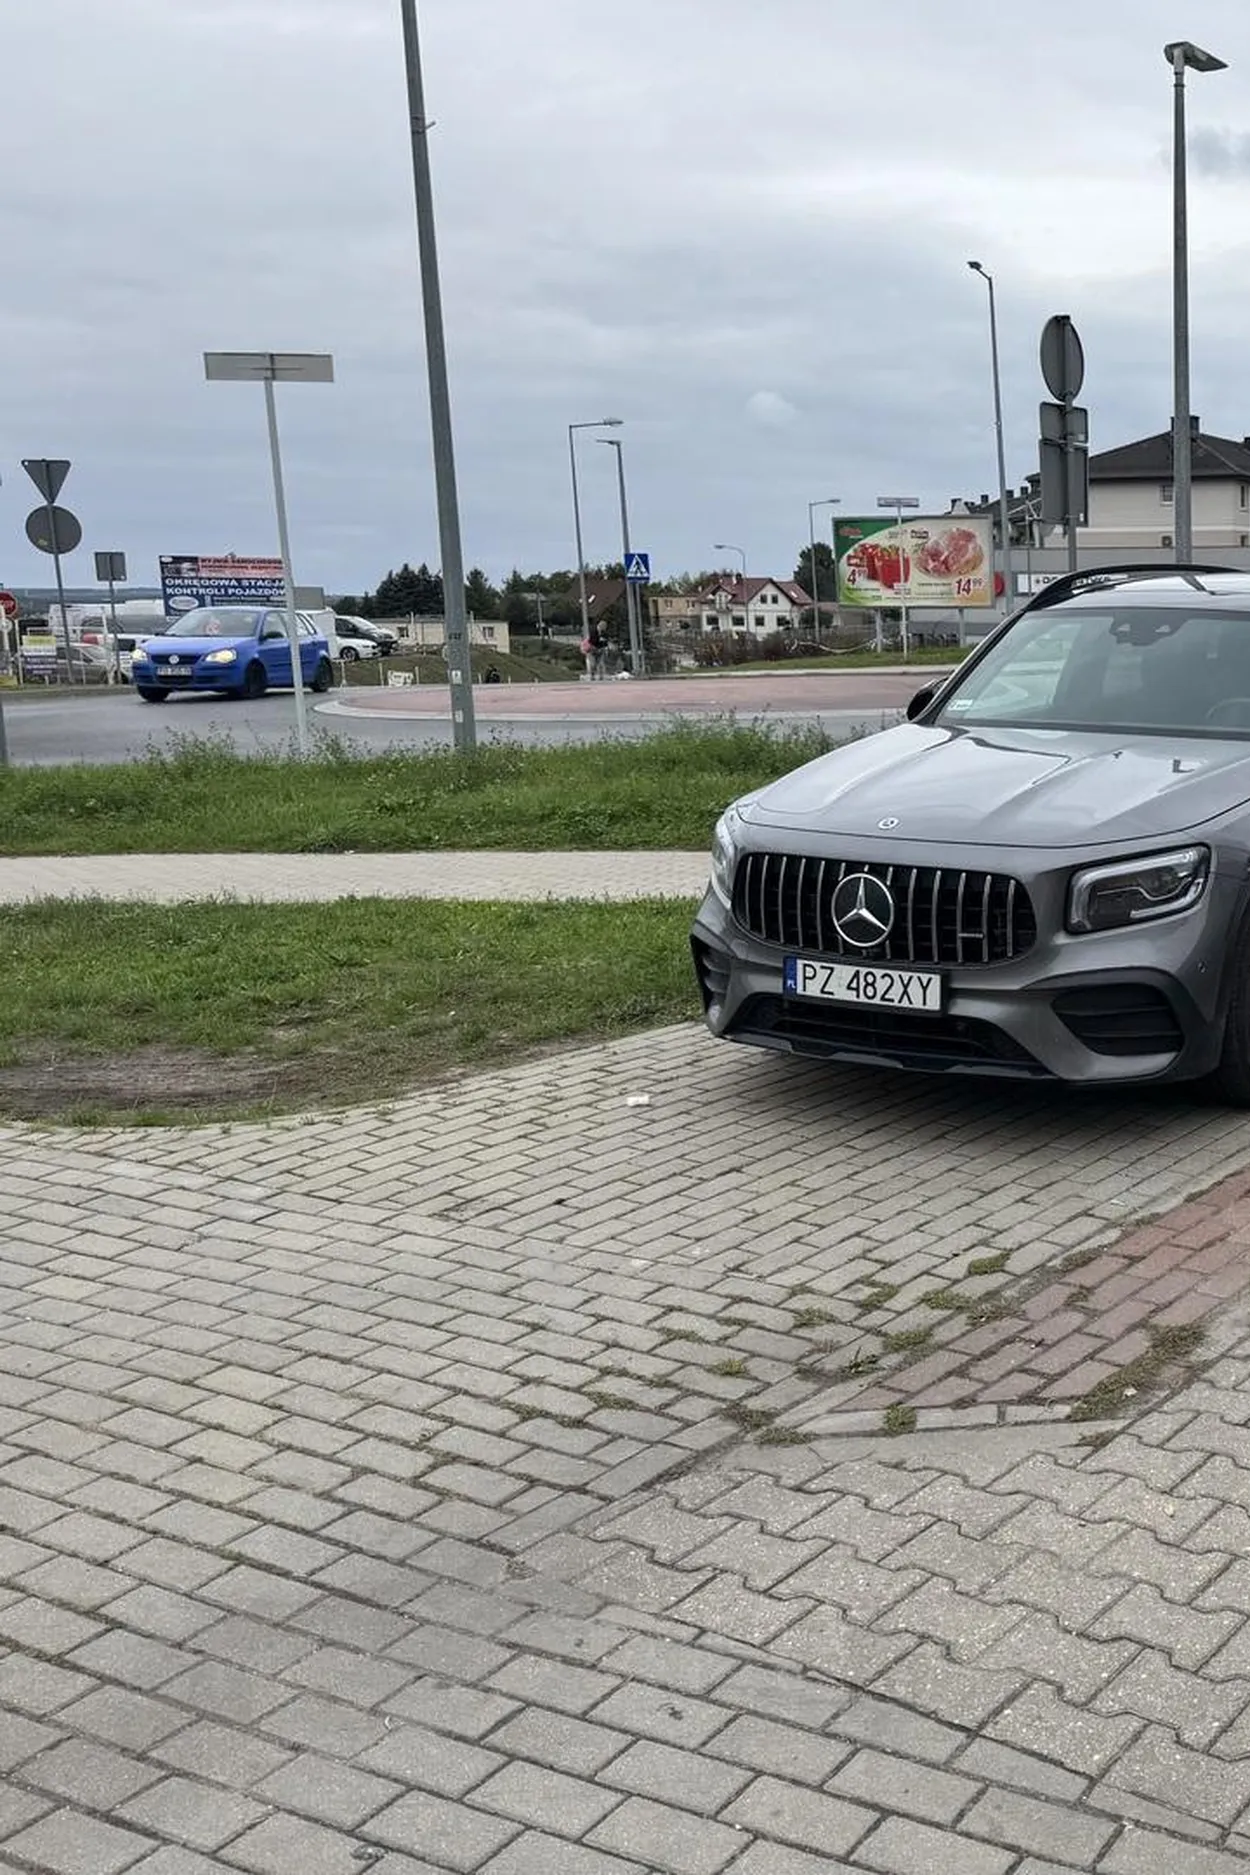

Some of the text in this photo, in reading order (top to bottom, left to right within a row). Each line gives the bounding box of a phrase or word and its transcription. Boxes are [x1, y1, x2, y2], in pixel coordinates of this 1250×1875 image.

[165, 578, 239, 588] OKRĘGOWA
[165, 587, 225, 596] KONTROLI
[802, 962, 933, 1007] PZ 482XY
